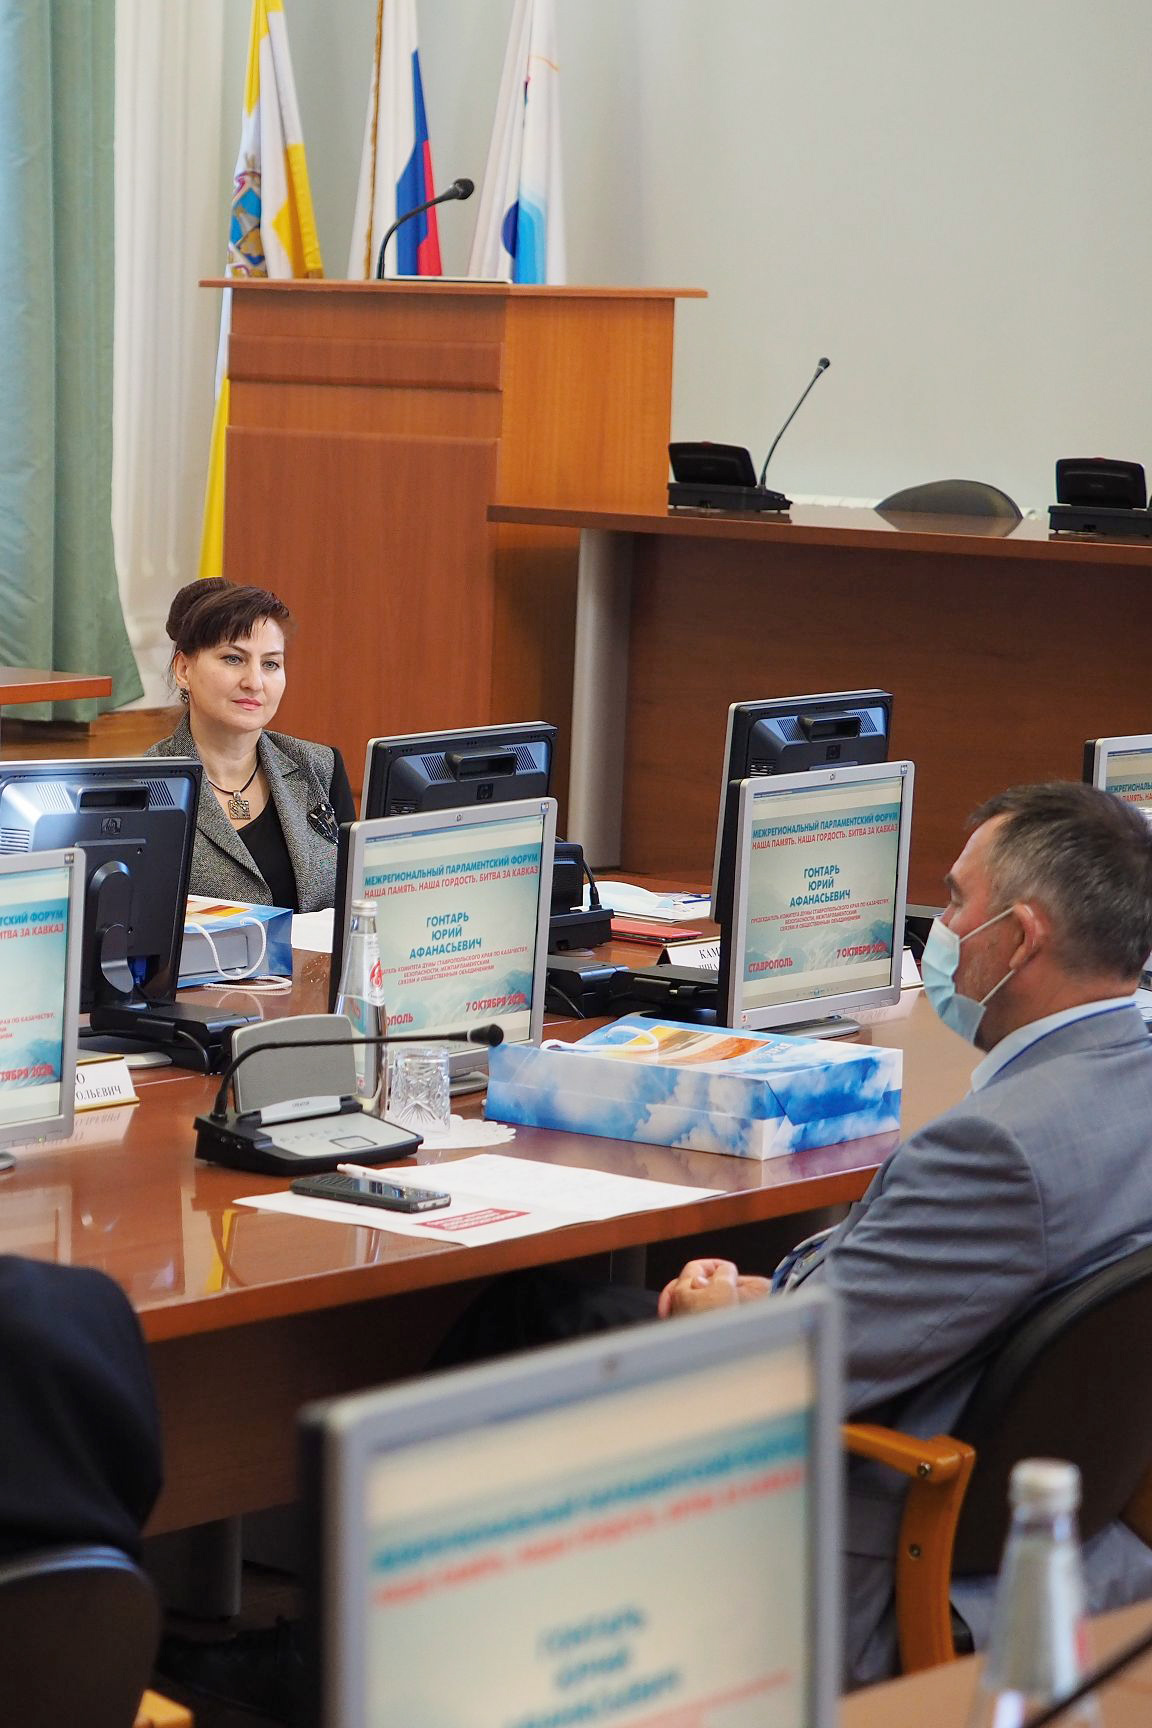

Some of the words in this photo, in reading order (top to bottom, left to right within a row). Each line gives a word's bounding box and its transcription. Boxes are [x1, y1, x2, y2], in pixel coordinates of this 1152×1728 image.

[752, 820, 818, 839] МЕЖРЕГИОНАЛЬНЫЙ
[820, 814, 874, 830] ПАРЛАМЕНТСКИЙ
[874, 812, 898, 823] ФОРУМ
[752, 839, 770, 850] НАША
[771, 836, 796, 847] ПАМЯТЬ.
[798, 834, 816, 844] НАША
[816, 830, 848, 842] ГОРДОСТЬ.
[848, 827, 866, 838] БИТВА
[868, 826, 874, 836] ЗА
[876, 824, 898, 835] КАВКАЗ
[364, 865, 444, 887] МЕЖРЕГИОНАЛЬНЫЙ
[446, 856, 510, 875] ПАРЛАМЕНТСКИЙ
[510, 853, 538, 866] ФОРУМ
[804, 865, 840, 878] ГОНТАРЬ
[364, 886, 386, 899] НАША
[388, 882, 417, 896] ПАМЯТЬ.
[418, 879, 440, 891] НАША
[441, 874, 478, 888] ГОРДОСТЬ.
[479, 871, 501, 883] БИТВА
[502, 869, 511, 879] ЗА
[512, 866, 539, 878] КАВКАЗ
[809, 876, 834, 891] ЮРИЙ
[790, 890, 850, 907] АФАНАСЬЕВИЧ
[30, 910, 64, 923] ФОРУМ
[426, 912, 469, 928] ГОНТАРЬ
[20, 927, 30, 938] ЗА
[32, 923, 64, 937] КАВКАЗ
[432, 924, 462, 941] ЮРИЙ
[410, 938, 482, 959] АФАНАСЬЕВИЧ
[837, 950, 840, 958] 7
[842, 944, 870, 957] ОКТЯБРЯ
[749, 958, 793, 972] СТАВРОПОЛЬ
[466, 1003, 470, 1012] 7
[472, 994, 506, 1011] ОКТЯБРЯ
[386, 1013, 414, 1026] ОПОЛЬ
[76, 1085, 121, 1100] ОЛЬЕВИЧ
